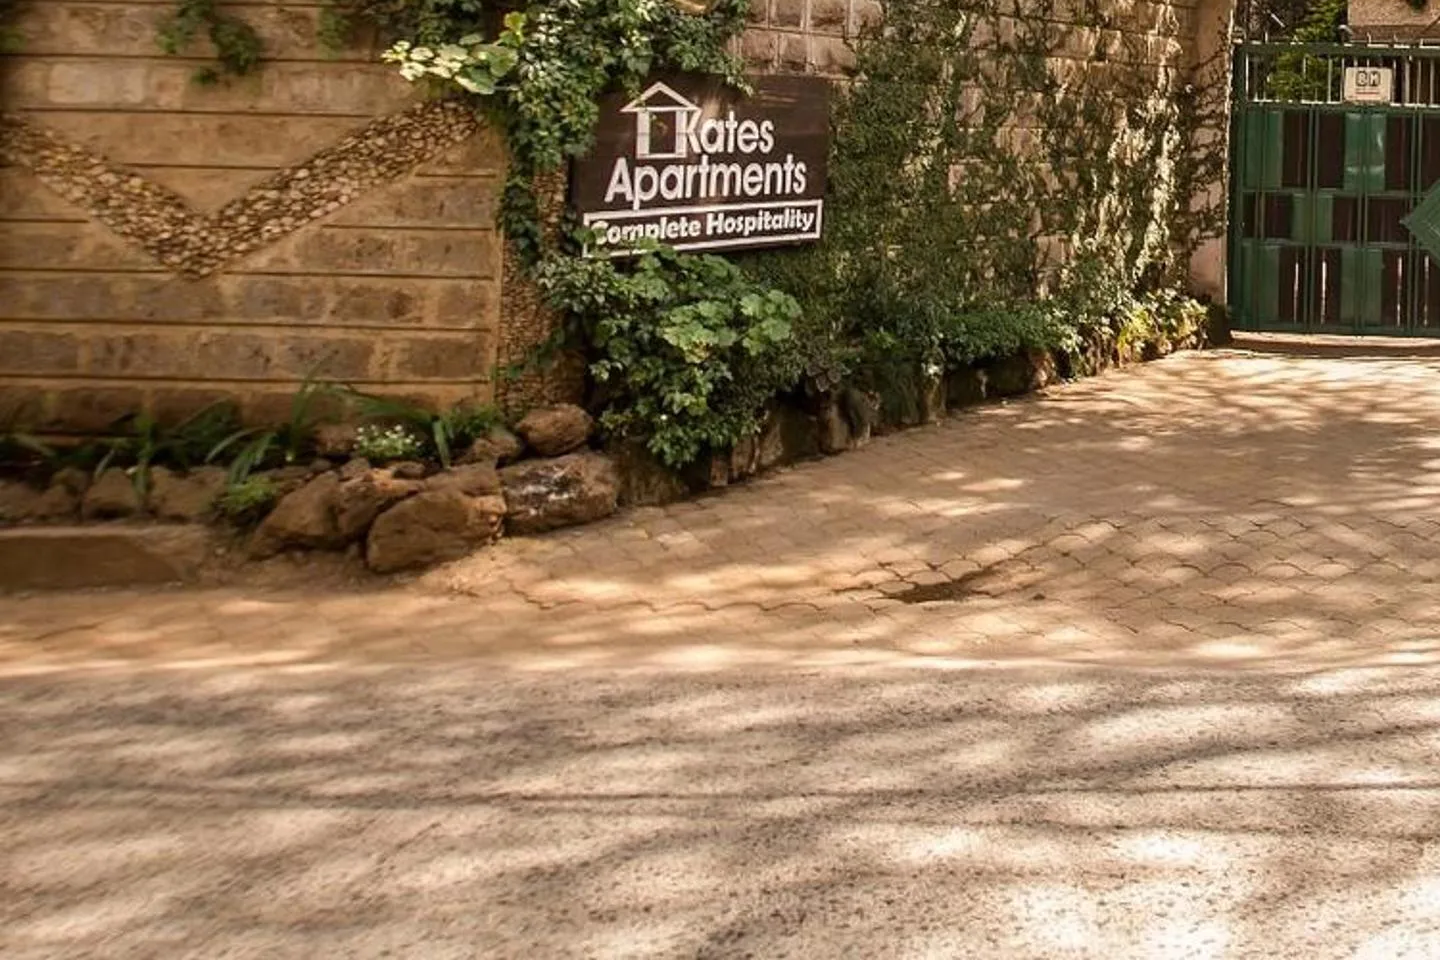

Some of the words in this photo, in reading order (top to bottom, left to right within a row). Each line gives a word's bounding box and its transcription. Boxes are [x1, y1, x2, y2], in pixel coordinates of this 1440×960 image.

[675, 109, 775, 158] Kates
[604, 153, 807, 211] Apartments
[591, 216, 701, 245] Complete
[706, 208, 815, 237] Hospitality
